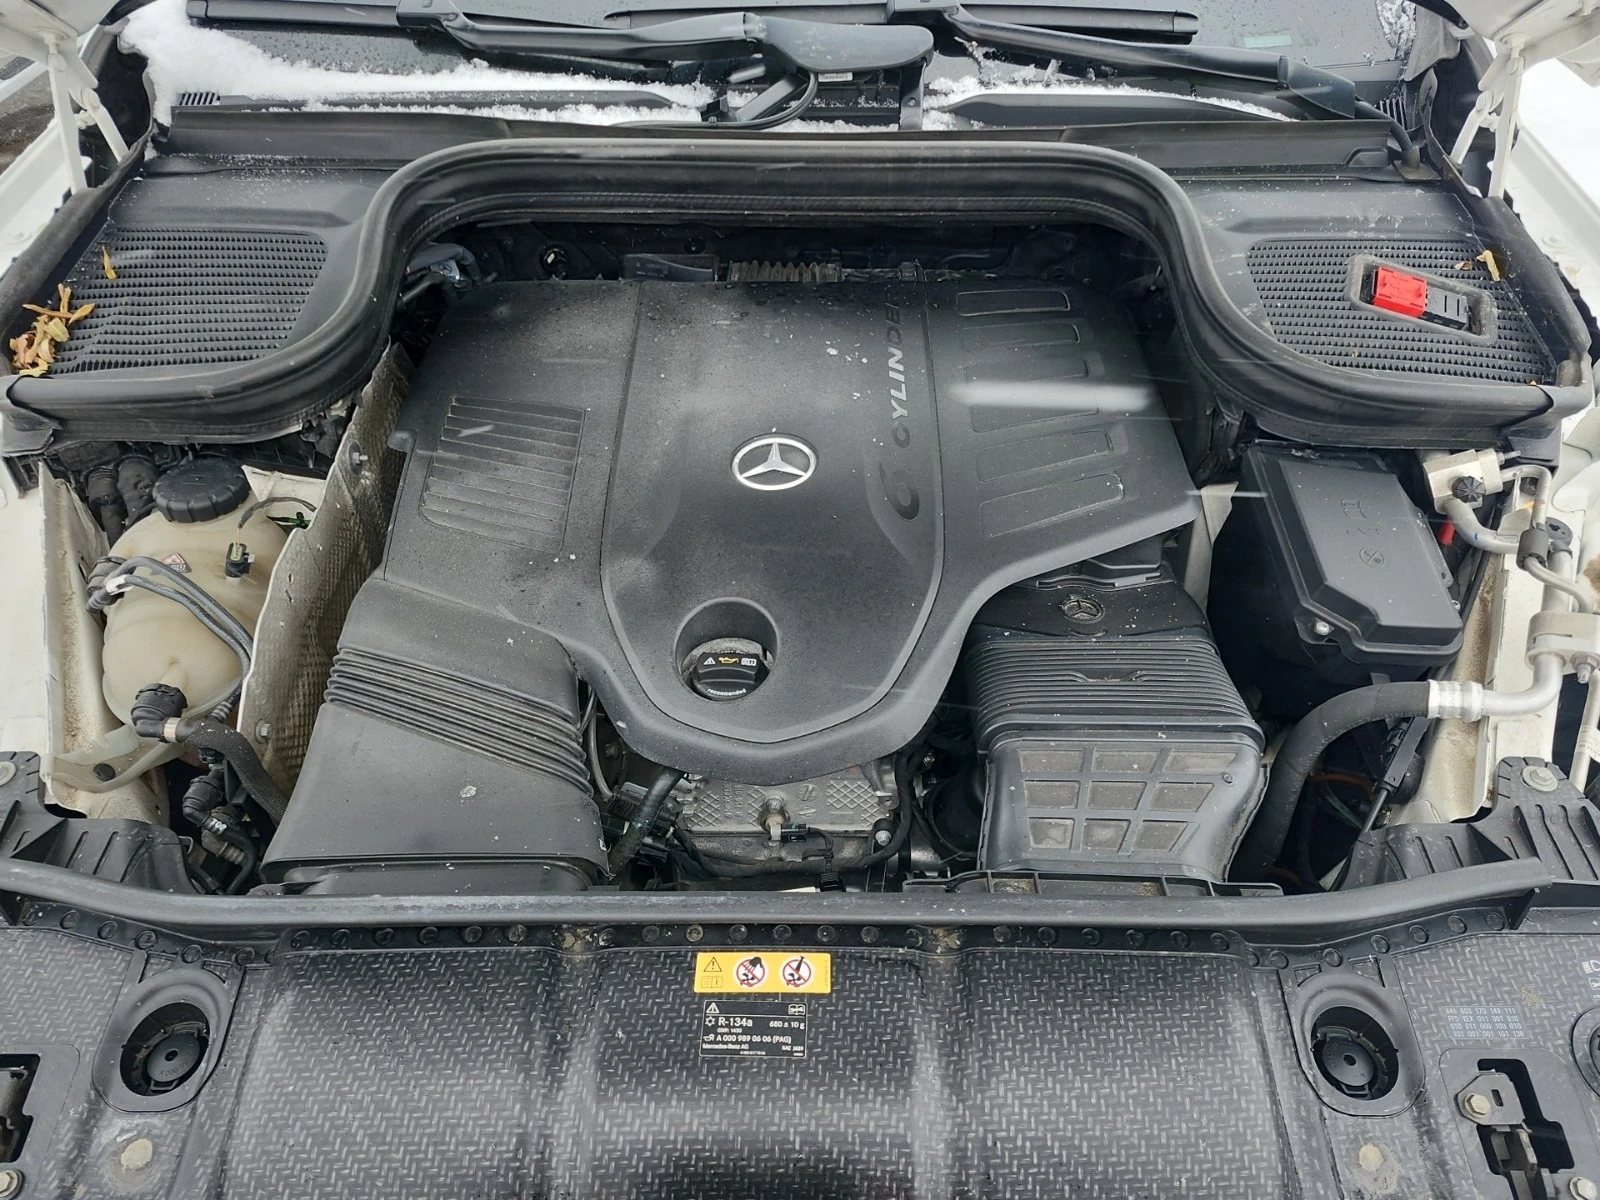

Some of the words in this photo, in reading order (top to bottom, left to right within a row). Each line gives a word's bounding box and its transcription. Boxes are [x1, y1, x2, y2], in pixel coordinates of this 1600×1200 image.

[885, 290, 912, 449] CYLINDE
[879, 461, 920, 520] 6
[707, 688, 746, 696] recommended
[718, 1017, 753, 1027] R-134a
[769, 1020, 783, 1028] 680
[799, 1022, 805, 1030] g
[762, 1035, 772, 1043] 06
[772, 1035, 792, 1044] (PAG)
